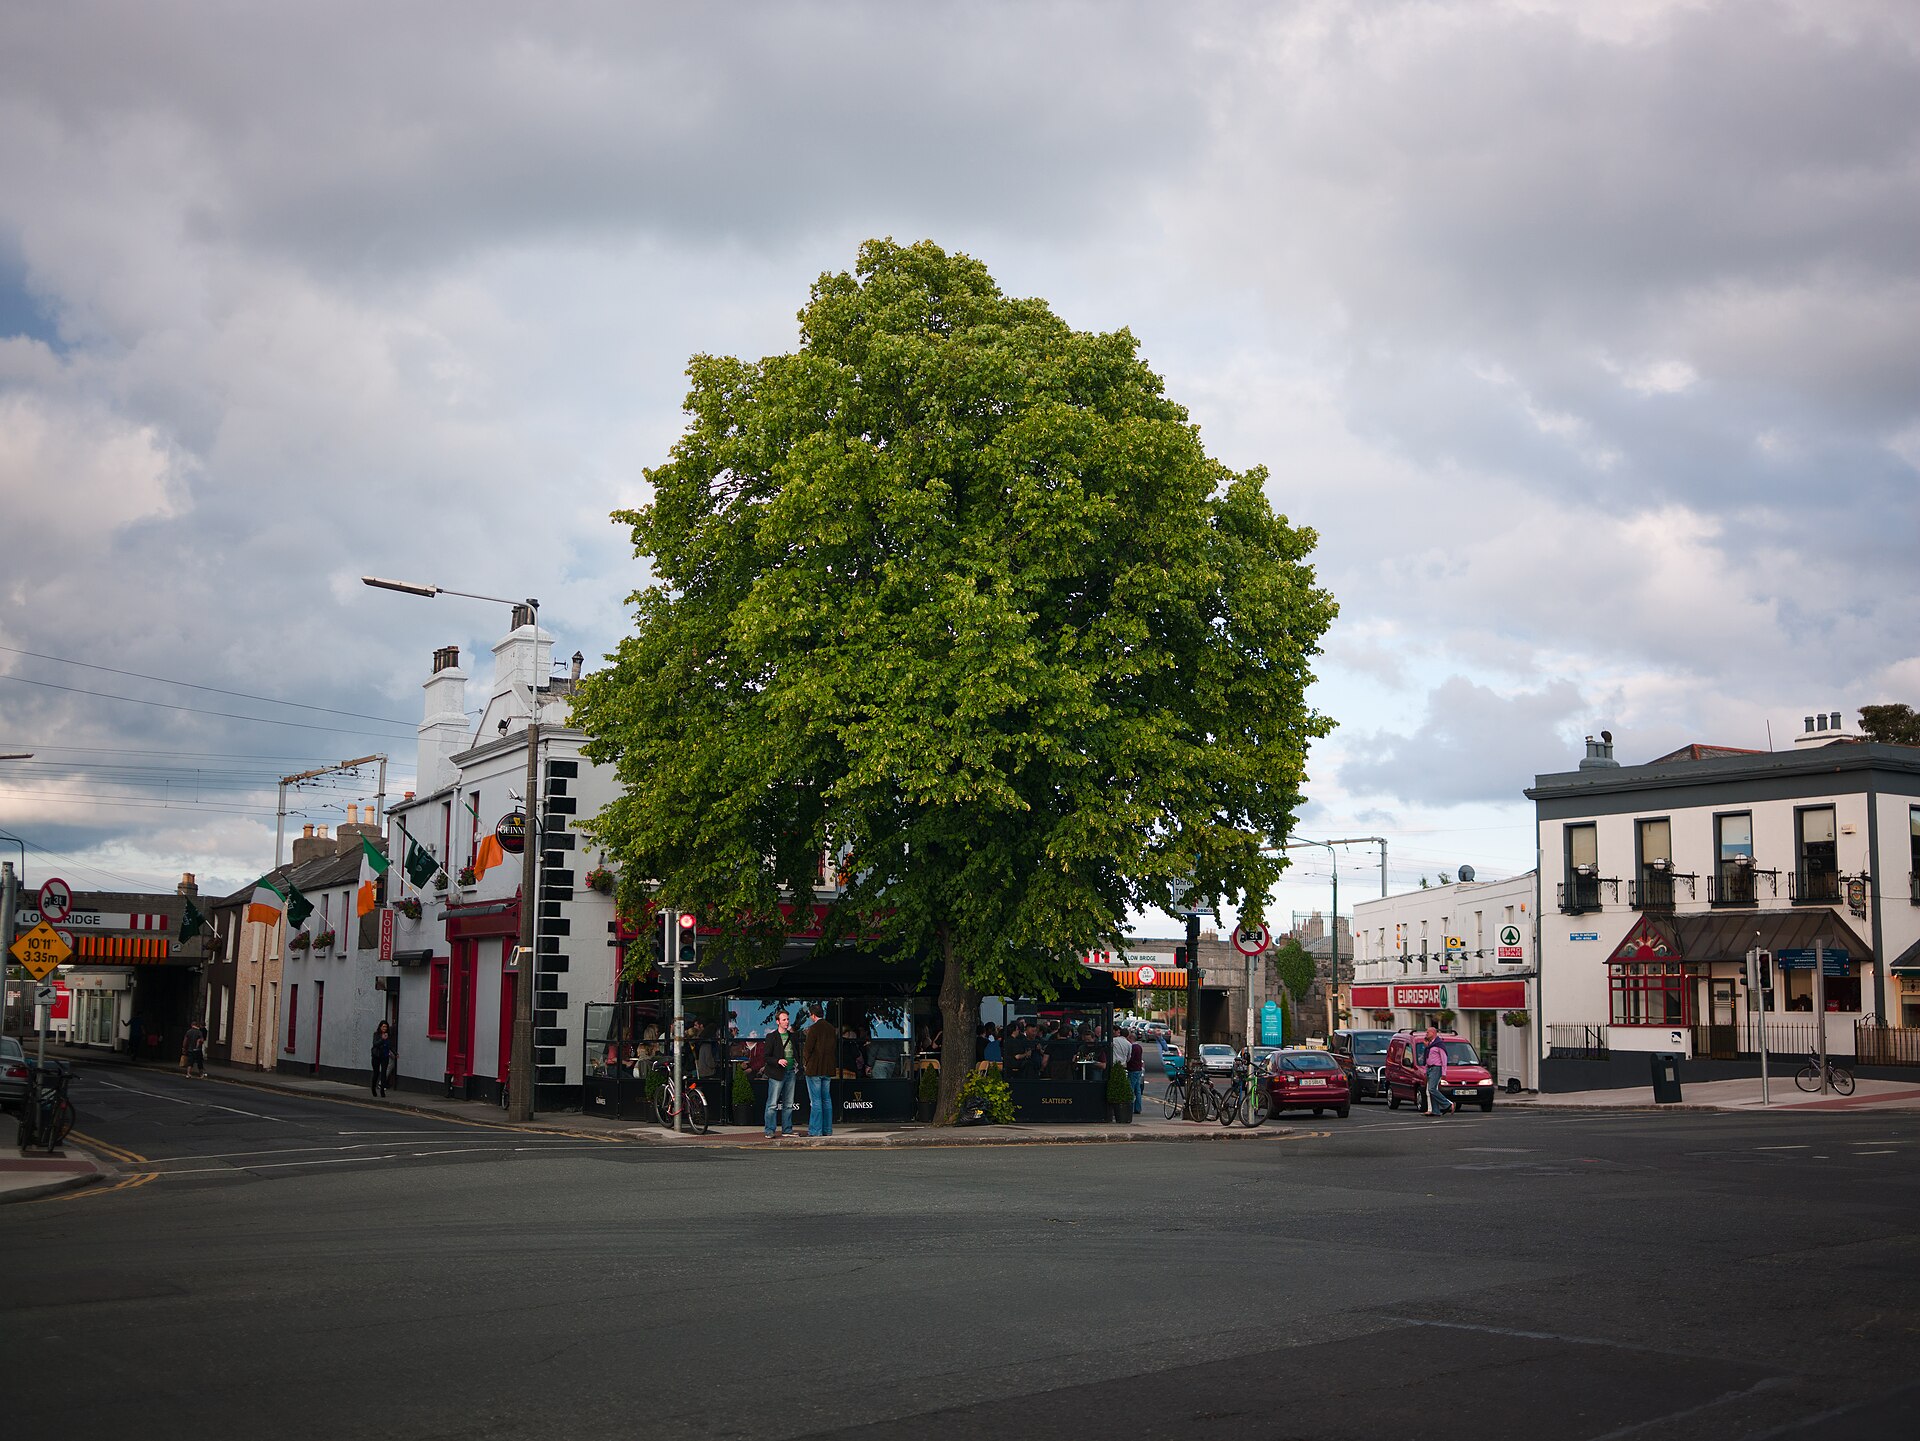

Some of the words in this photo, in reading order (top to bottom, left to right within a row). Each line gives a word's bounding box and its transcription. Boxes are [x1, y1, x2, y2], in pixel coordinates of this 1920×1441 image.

[63, 914, 101, 925] RIDGE
[382, 911, 391, 959] LOUNGE
[23, 951, 58, 963] 3.35m
[1398, 989, 1440, 1004] EUROSPAR
[843, 1100, 873, 1109] GUINNESS
